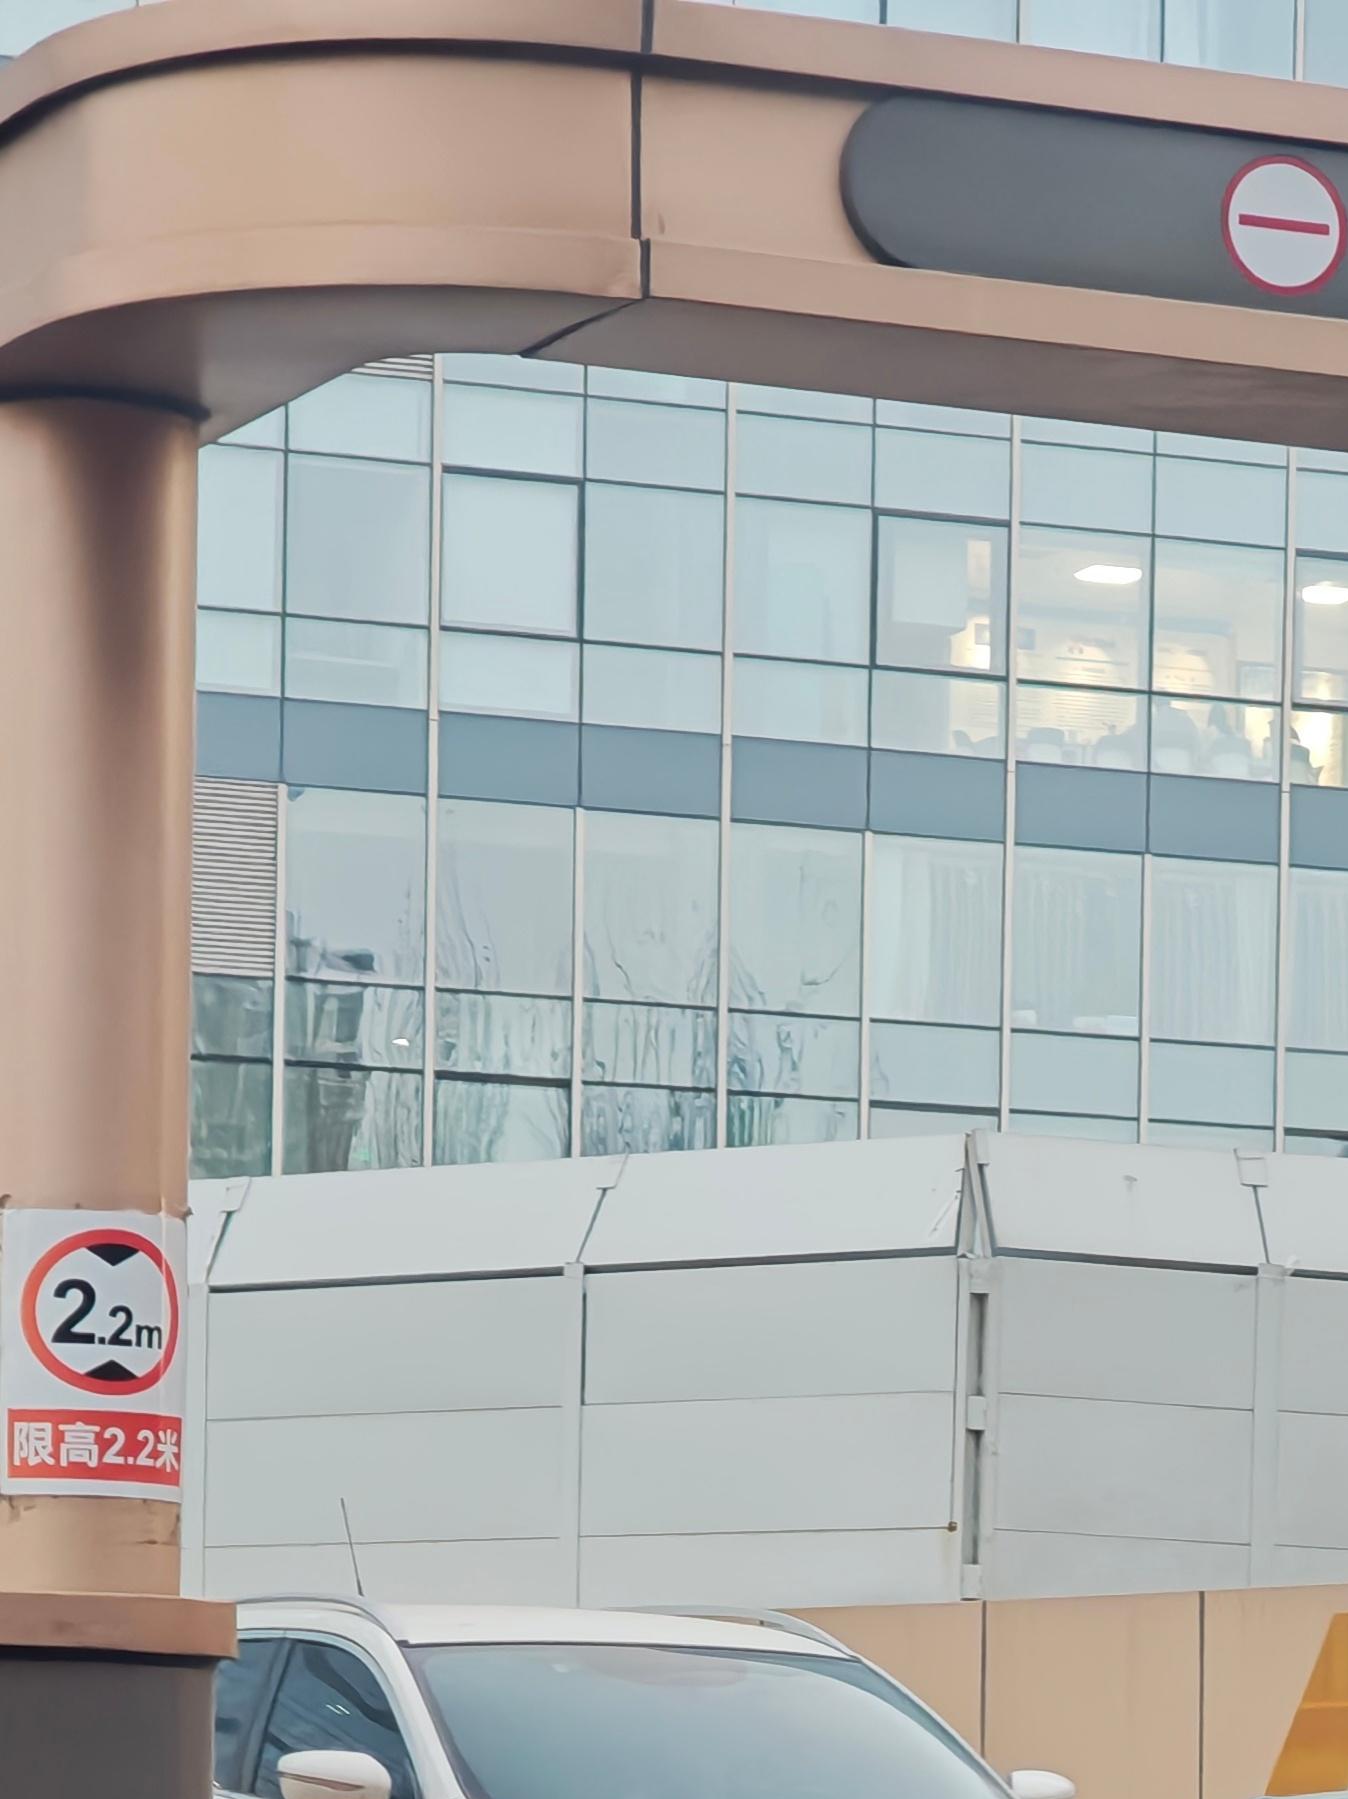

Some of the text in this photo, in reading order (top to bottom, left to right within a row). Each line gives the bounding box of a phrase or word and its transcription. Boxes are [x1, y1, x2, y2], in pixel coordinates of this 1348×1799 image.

[51, 1278, 162, 1350] 2.2m
[12, 1421, 179, 1474] 限高2.2米
